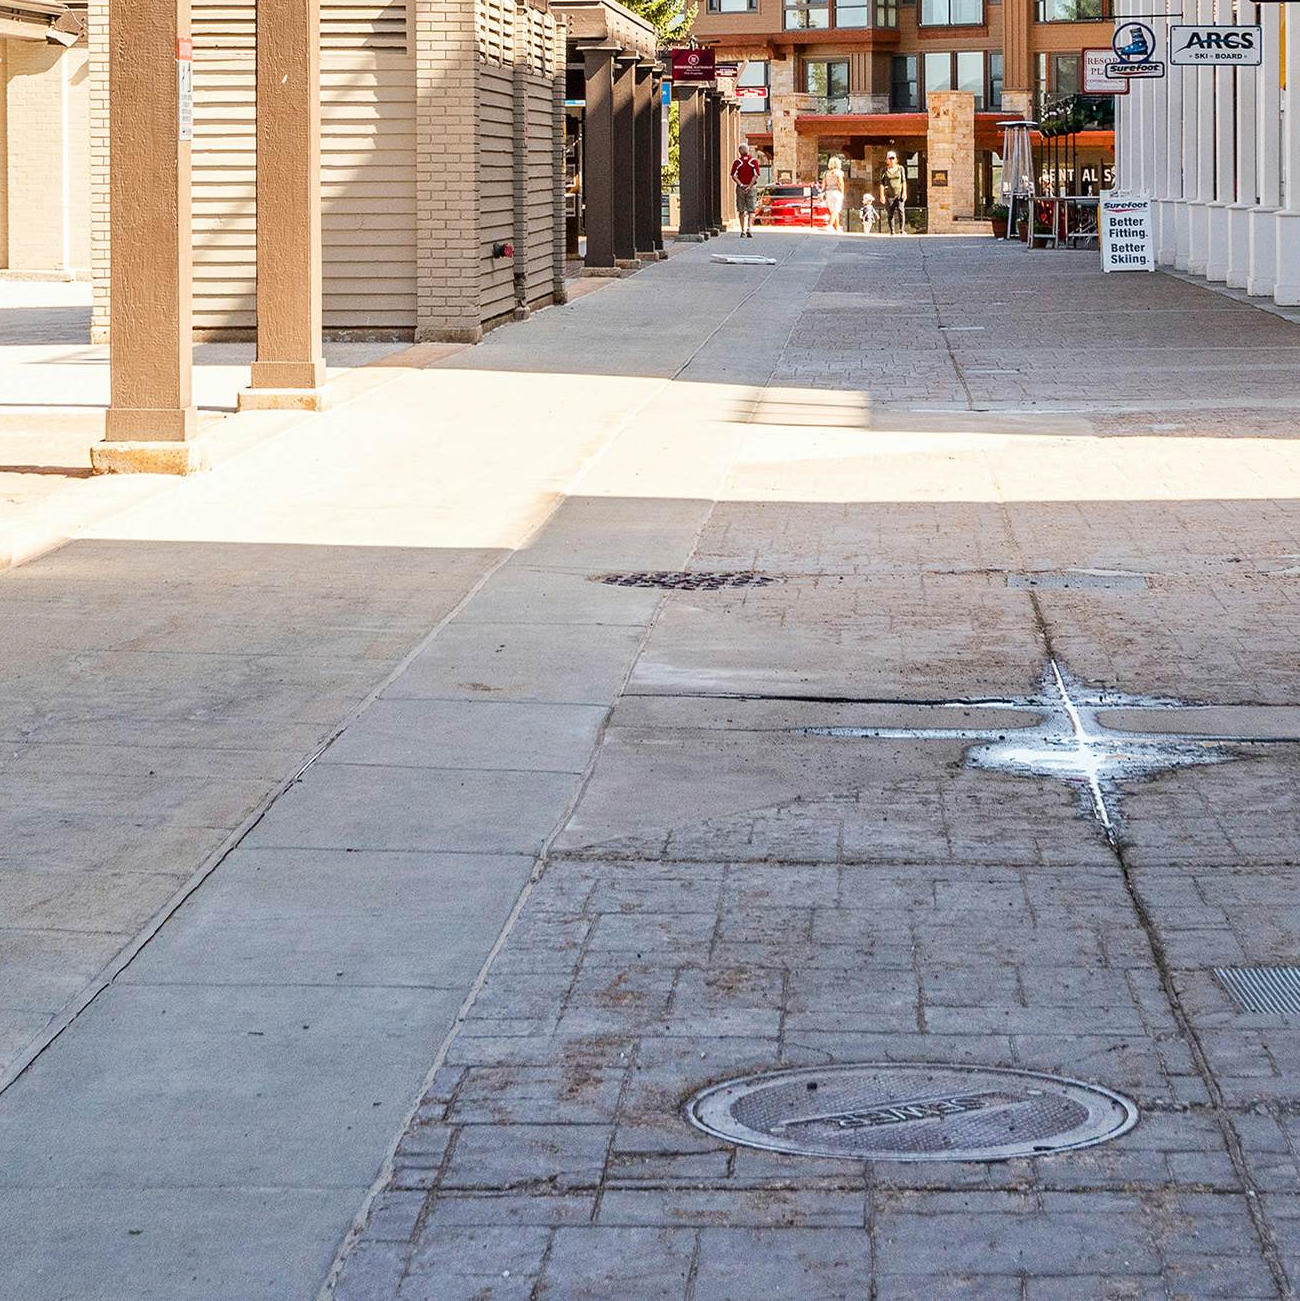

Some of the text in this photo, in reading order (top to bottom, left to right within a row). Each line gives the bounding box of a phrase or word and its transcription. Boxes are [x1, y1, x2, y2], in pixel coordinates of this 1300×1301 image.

[1185, 32, 1254, 49] ARCS
[1215, 52, 1243, 60] BOARD
[1110, 64, 1160, 73] Surefoot
[1103, 201, 1149, 209] Surefoot
[1109, 217, 1144, 227] Better
[1109, 229, 1148, 239] Fitting.
[1111, 243, 1145, 253] Better
[1111, 255, 1150, 265] Skiing.
